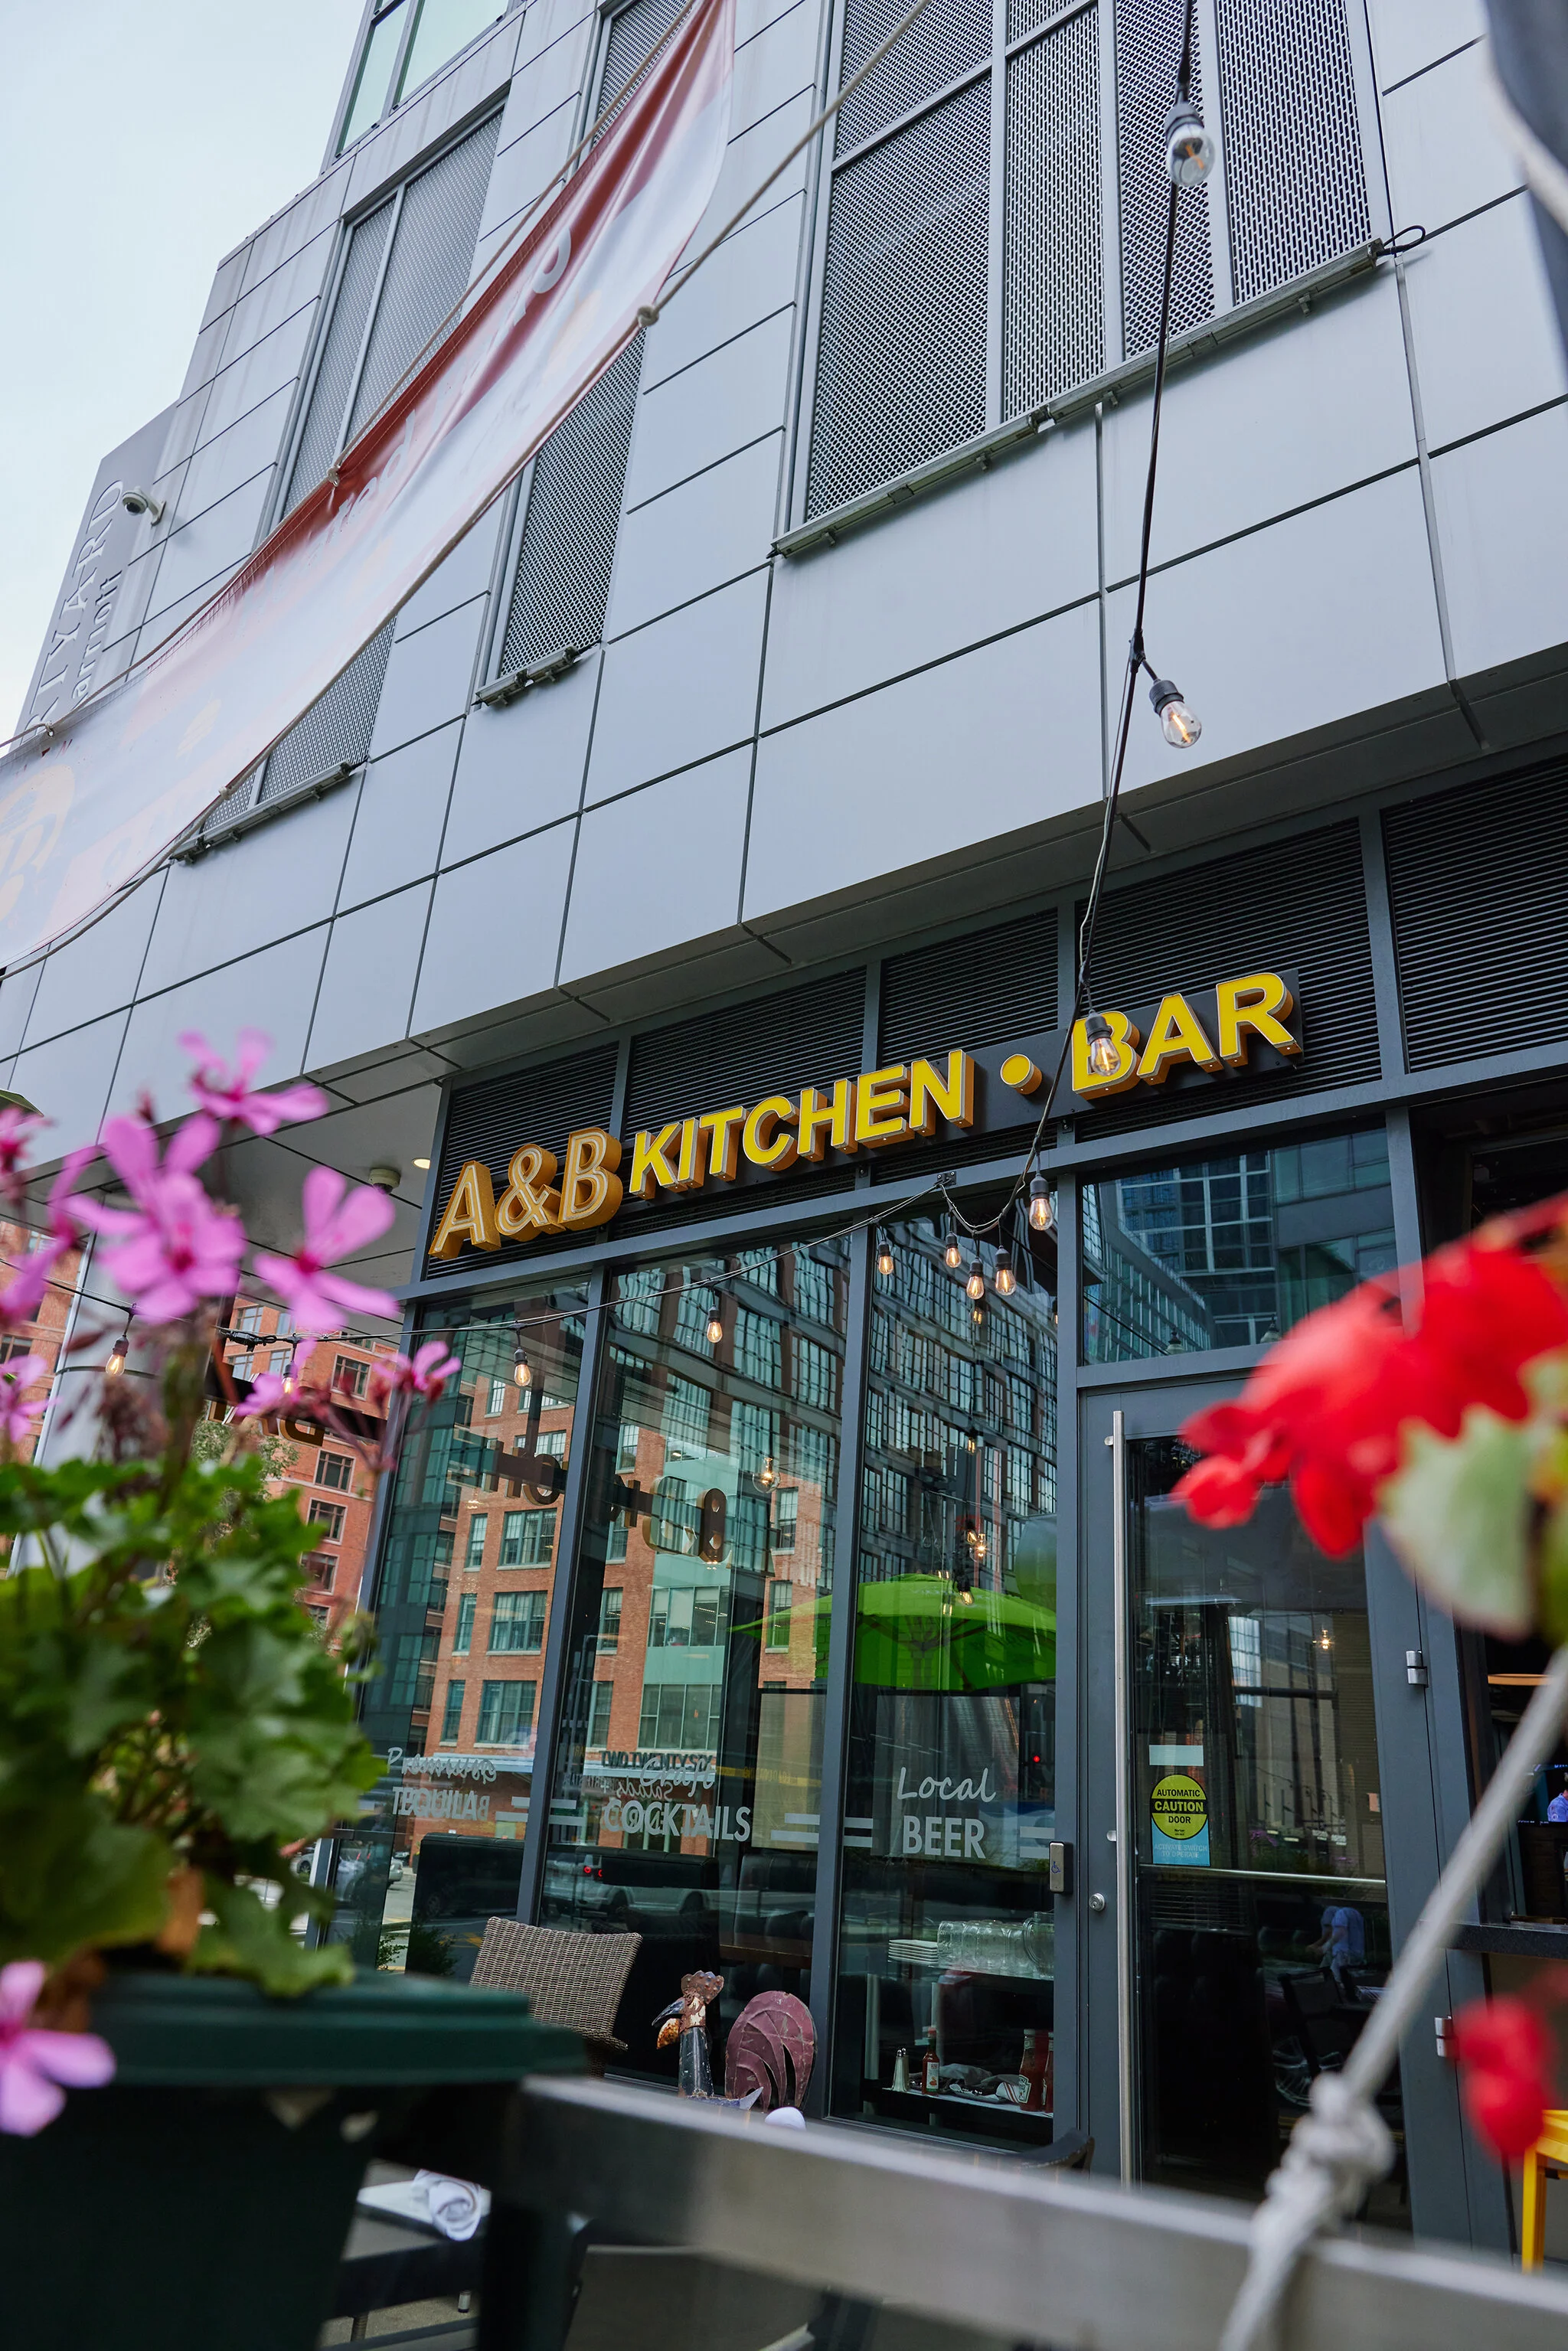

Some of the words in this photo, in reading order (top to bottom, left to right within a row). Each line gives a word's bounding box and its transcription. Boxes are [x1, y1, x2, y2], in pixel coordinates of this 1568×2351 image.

[20, 479, 123, 746] RTYARD
[429, 1127, 622, 1259] A&B
[629, 1050, 972, 1198] KITCHEN
[1072, 973, 1300, 1098] BAR
[640, 1756, 717, 1798] Craft
[897, 1767, 996, 1802] Local
[393, 1786, 478, 1821] TEQUILA
[603, 1798, 751, 1842] COCKTAILS
[1154, 1801, 1204, 1812] CAUTION
[903, 1815, 986, 1859] BEER
